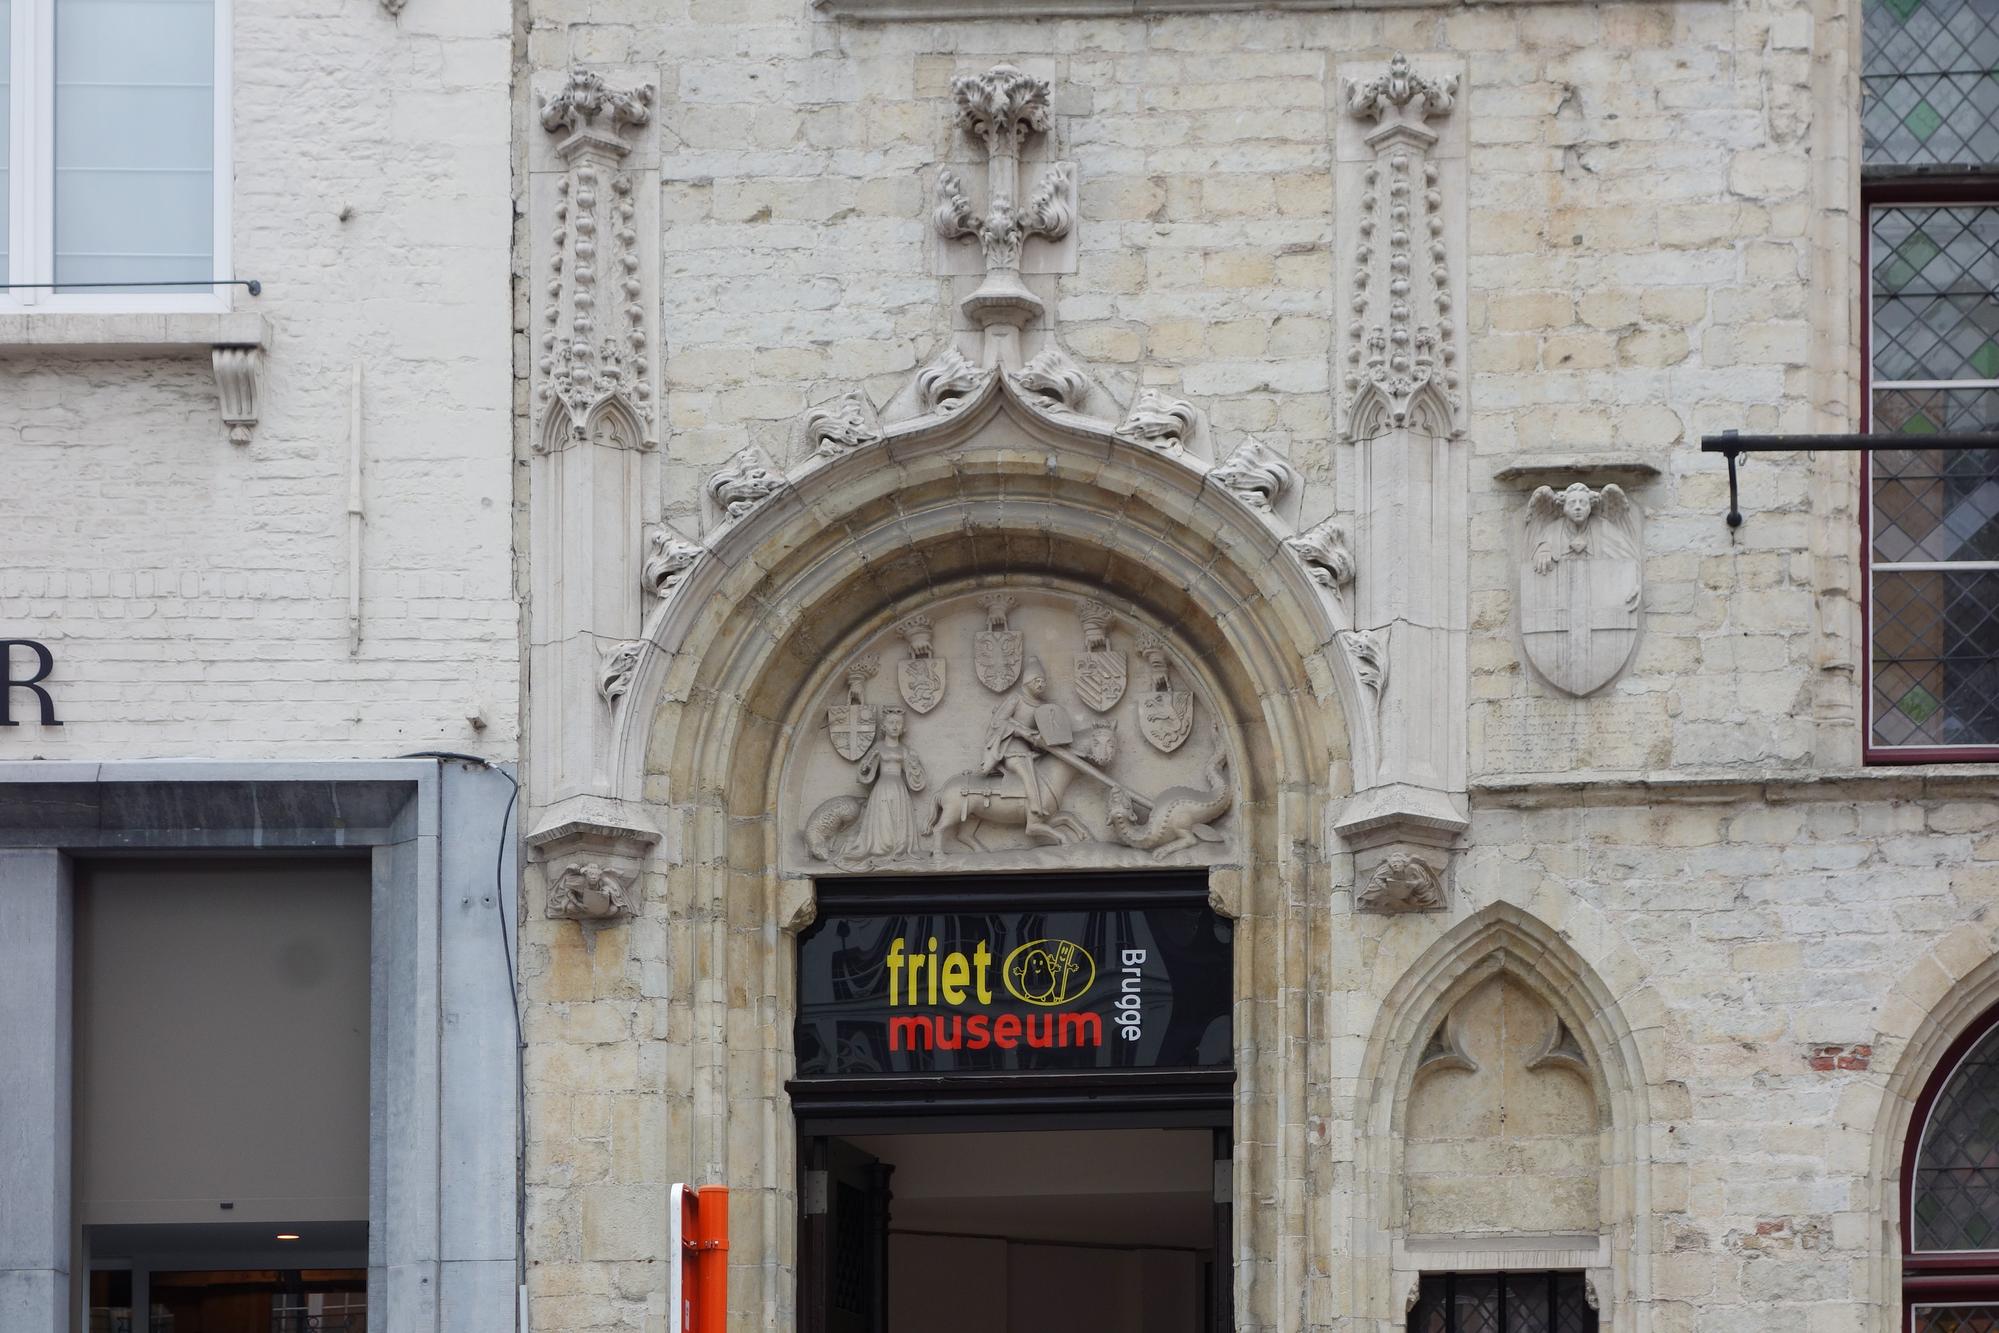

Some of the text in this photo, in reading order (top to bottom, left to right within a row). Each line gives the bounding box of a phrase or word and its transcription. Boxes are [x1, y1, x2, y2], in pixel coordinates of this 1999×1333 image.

[0, 640, 63, 726] R
[887, 937, 992, 1006] friet
[1114, 949, 1146, 1041] Brugge
[888, 1010, 1102, 1051] museum
